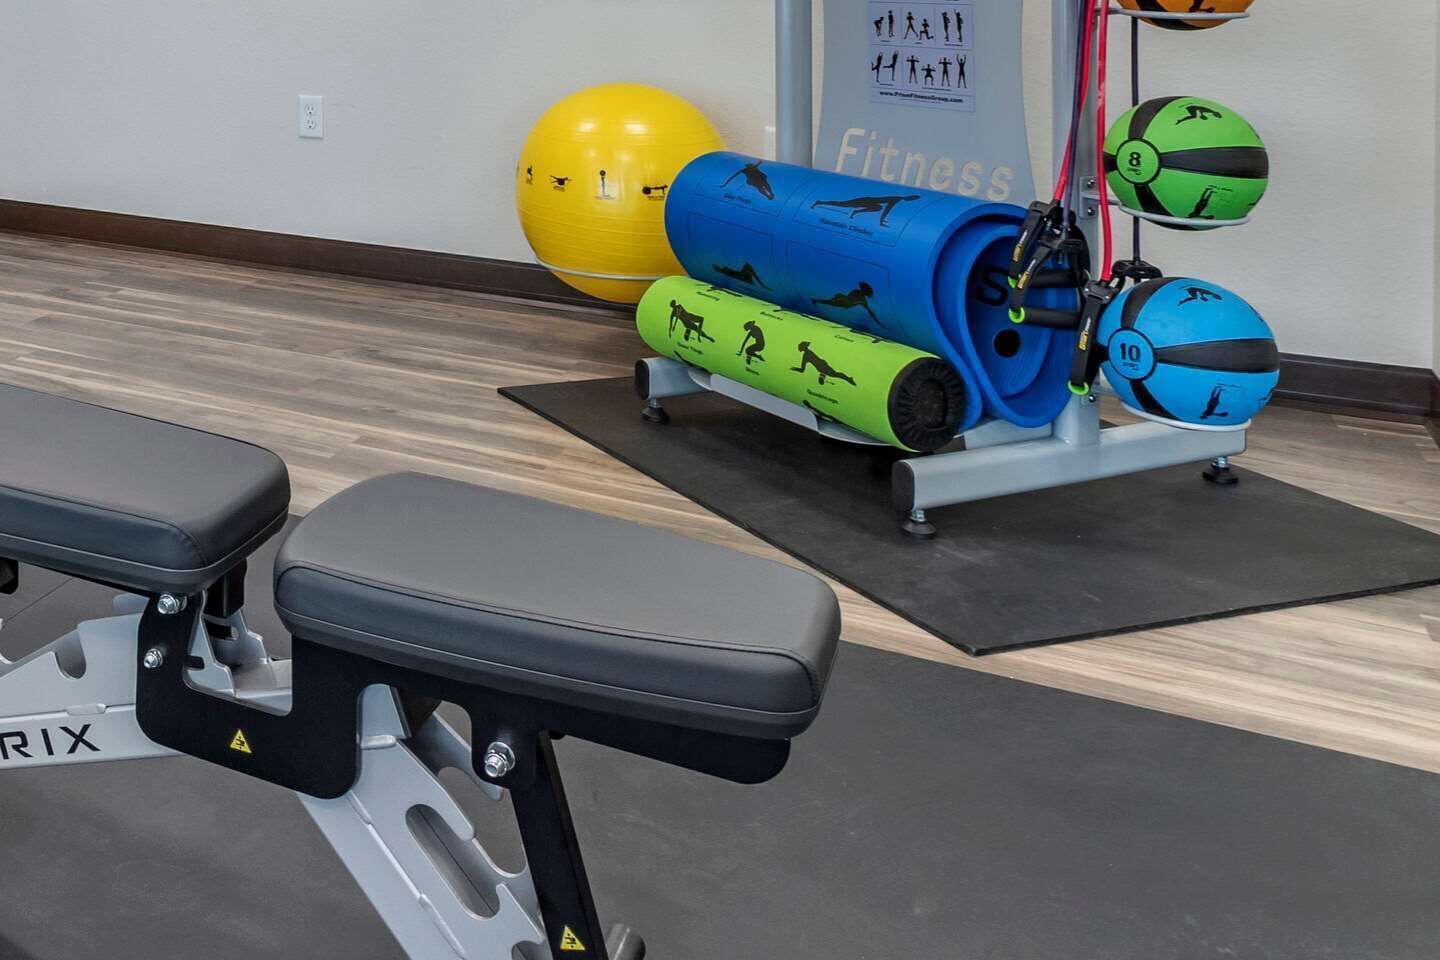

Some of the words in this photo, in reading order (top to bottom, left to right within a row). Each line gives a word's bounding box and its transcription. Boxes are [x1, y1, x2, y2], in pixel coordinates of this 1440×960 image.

[835, 127, 1014, 202] Fitness
[1128, 151, 1141, 167] 8
[1119, 342, 1141, 362] 10
